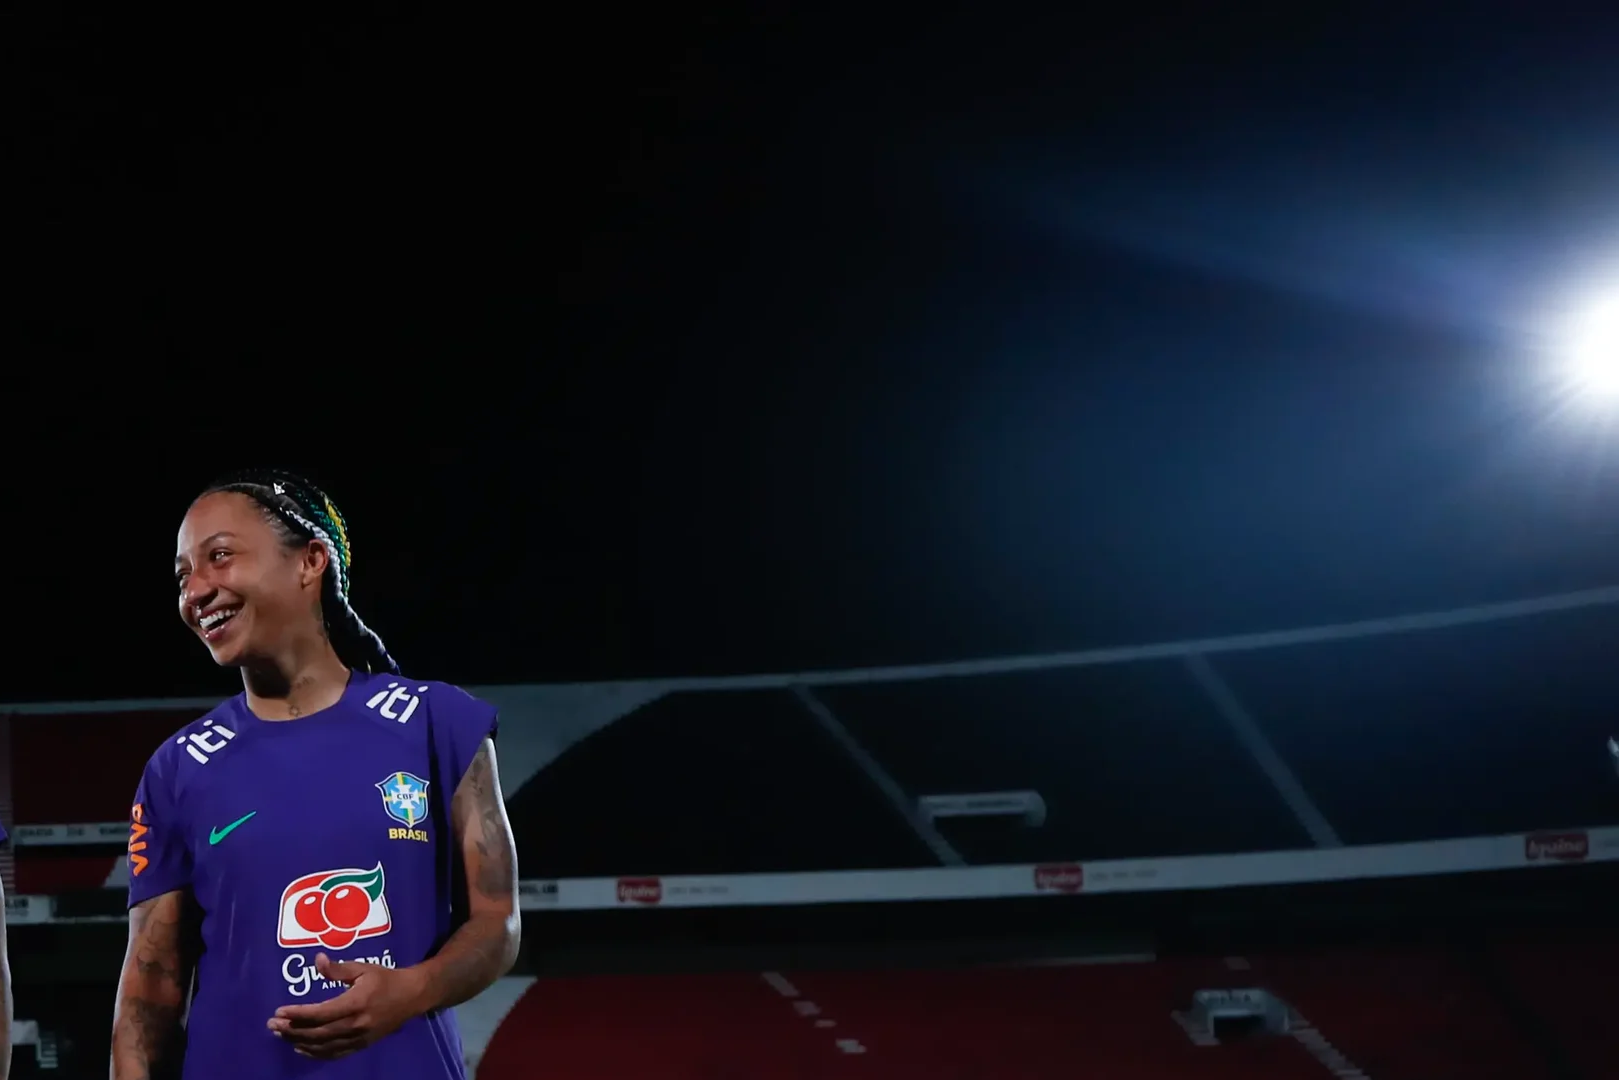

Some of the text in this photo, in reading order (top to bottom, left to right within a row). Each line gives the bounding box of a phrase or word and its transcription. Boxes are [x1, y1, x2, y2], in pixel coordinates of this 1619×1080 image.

[366, 682, 428, 724] iti
[176, 719, 236, 764] iti
[396, 793, 415, 801] CBF
[388, 828, 429, 842] BRASIL
